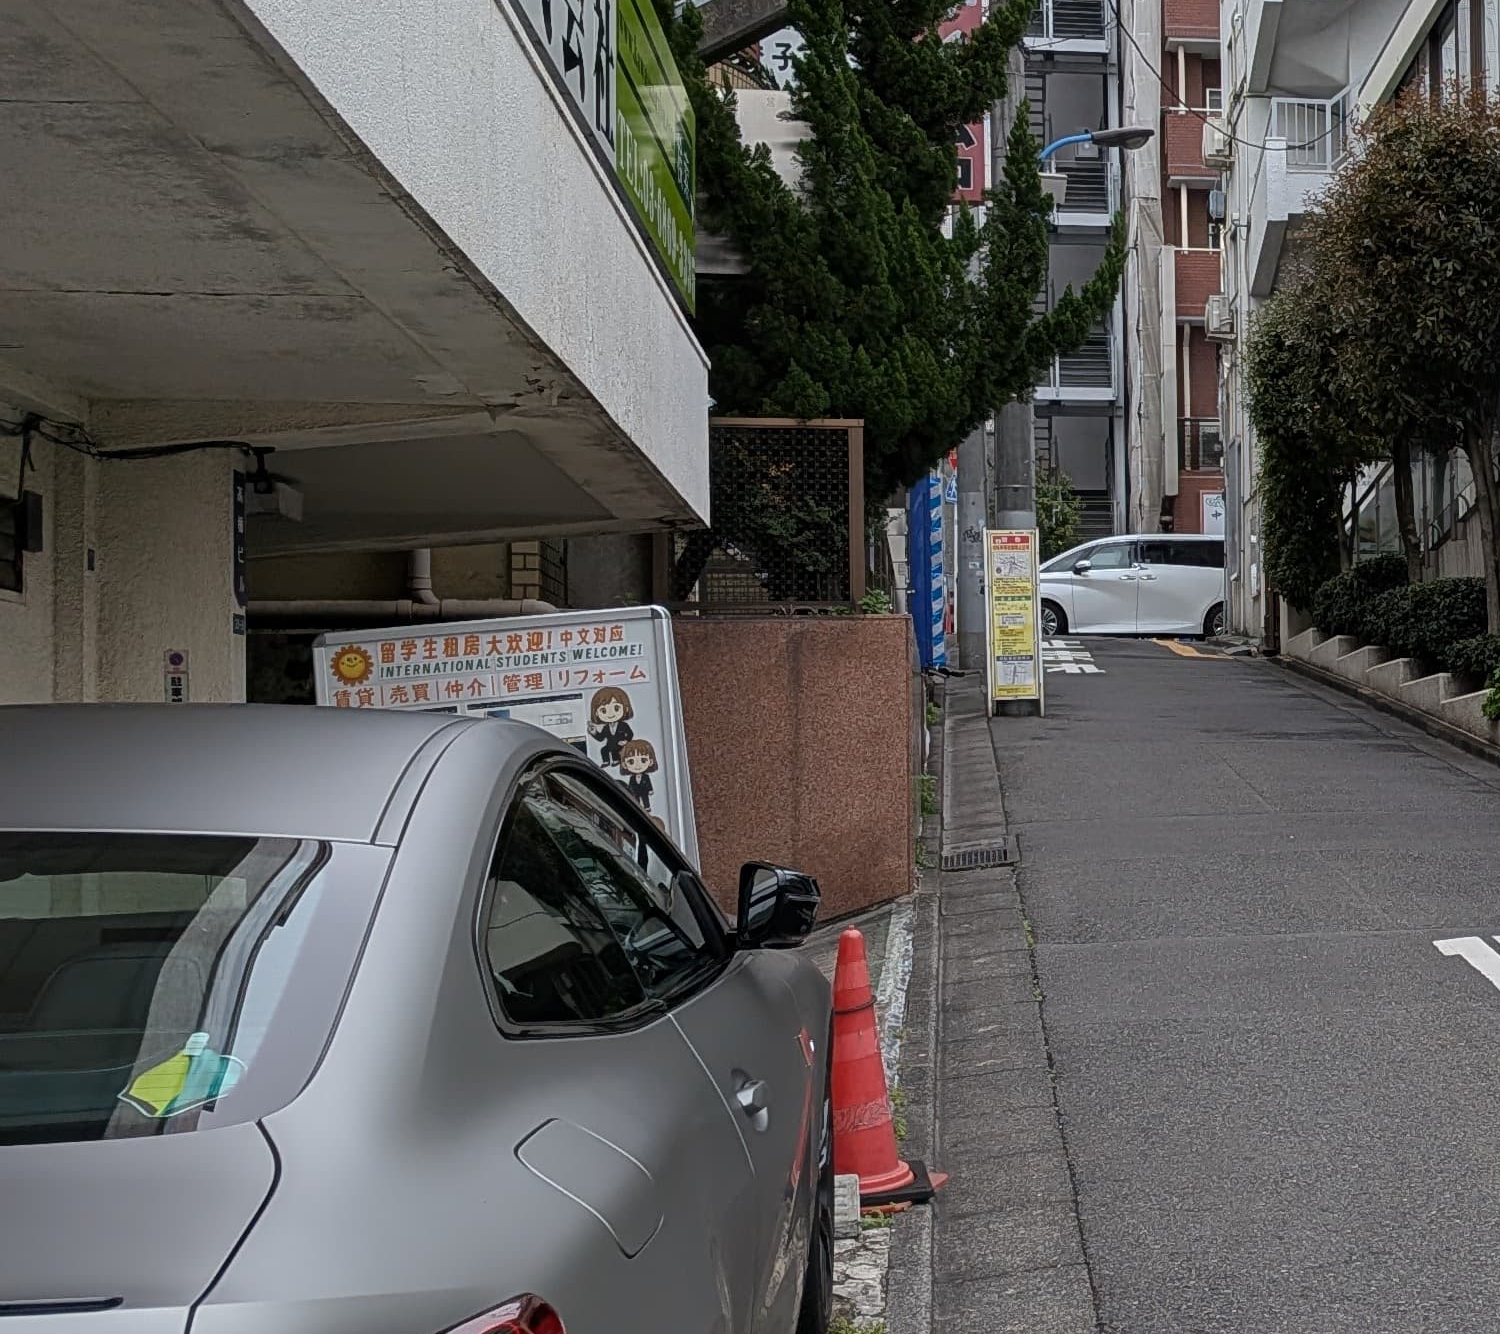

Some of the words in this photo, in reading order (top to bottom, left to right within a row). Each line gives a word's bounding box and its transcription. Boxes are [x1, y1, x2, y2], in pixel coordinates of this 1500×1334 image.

[380, 657, 491, 678] INTERNATIONAL
[495, 651, 567, 668] STUDENTS
[571, 644, 643, 661] WELCOME!
[389, 683, 431, 704] 売買
[444, 677, 487, 699] 仲介
[502, 672, 545, 694] 管理
[558, 664, 647, 687] リフォーム
